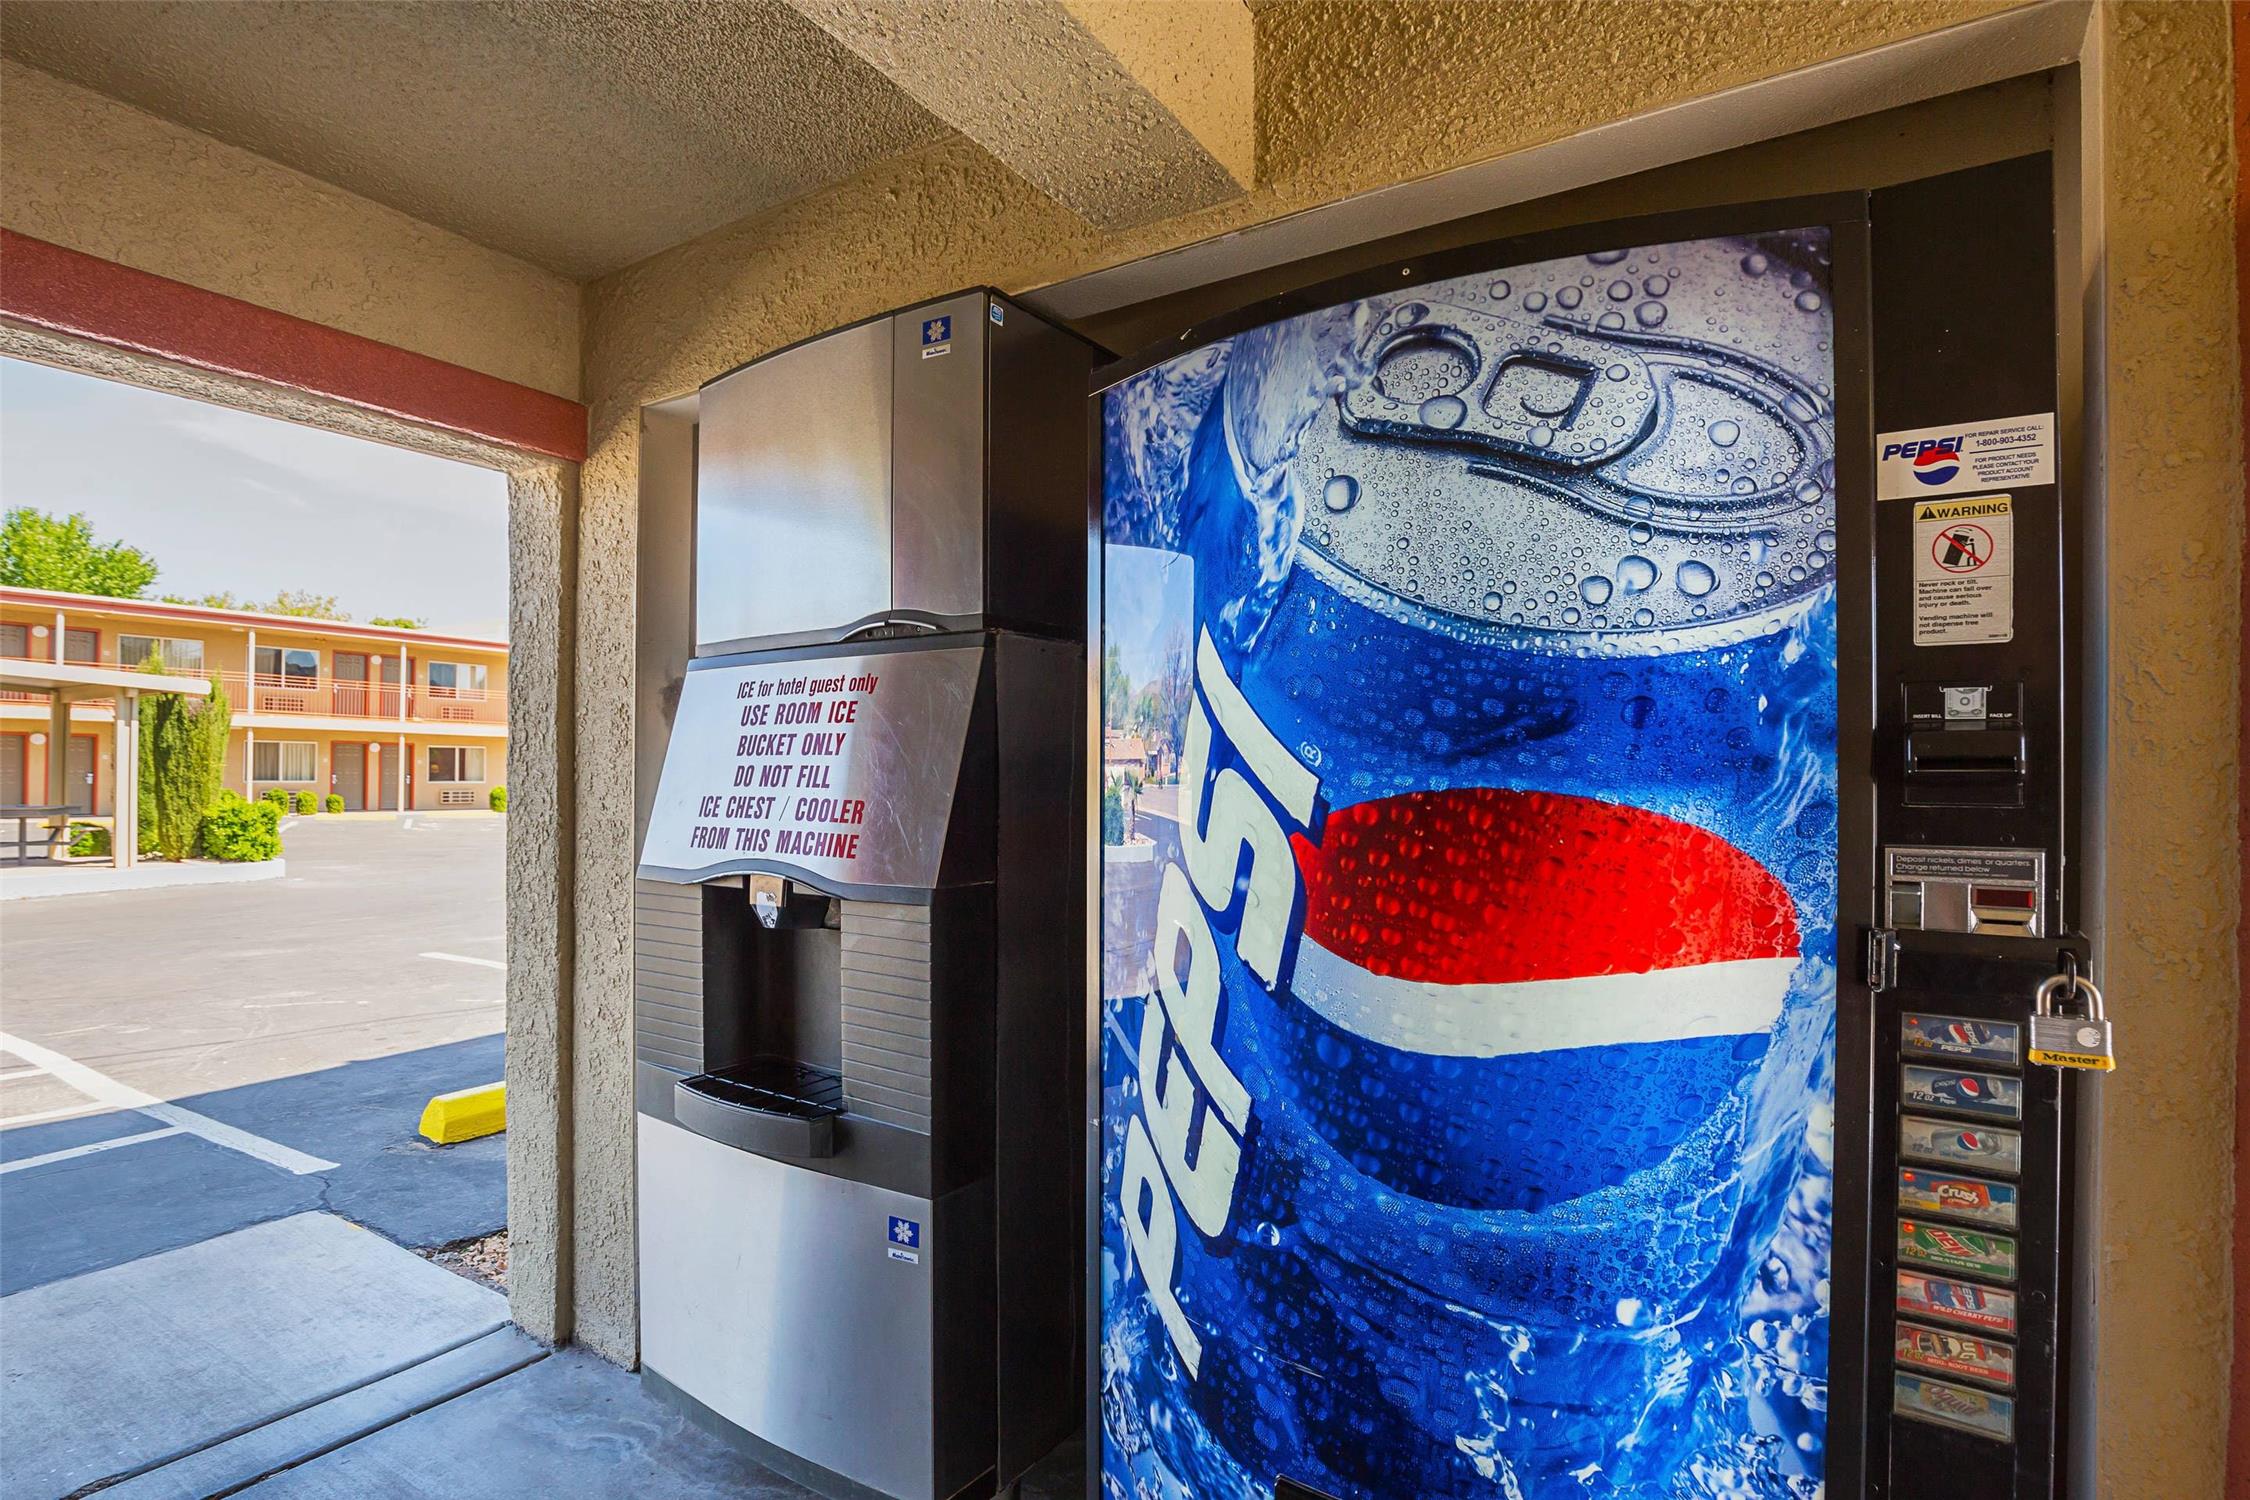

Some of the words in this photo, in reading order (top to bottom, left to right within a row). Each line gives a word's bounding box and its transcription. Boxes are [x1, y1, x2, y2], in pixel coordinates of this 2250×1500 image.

[2000, 427, 2025, 435] SERVICE
[1976, 433, 2036, 447] 1-800-903-4352
[1882, 436, 1964, 461] PEPSI
[1972, 462, 1995, 470] PLEASE
[1995, 460, 2022, 468] CONTACT
[1980, 473, 2030, 482] REPRESENTATIVE
[1937, 503, 2008, 518] WARNING
[737, 681, 756, 699] ICE
[757, 680, 774, 697] for
[776, 676, 807, 696] hotel
[809, 675, 845, 697] guest
[848, 673, 879, 694] only
[740, 704, 770, 727] USE
[774, 701, 823, 725] ROOM
[827, 700, 858, 724] ICE
[736, 733, 797, 756] BUCKET
[801, 733, 847, 756] ONLY
[733, 765, 754, 787] DO
[759, 765, 793, 788] NOT
[796, 765, 830, 788] FILL
[698, 795, 722, 818] ICE
[725, 795, 776, 820] CHEST
[778, 795, 791, 821] /
[794, 797, 866, 825] COOLER
[690, 826, 730, 850] FROM
[735, 827, 771, 853] THIS
[775, 829, 860, 859] MACHINE
[1896, 855, 1926, 863] Deposit
[1896, 863, 1929, 871] Change
[1120, 622, 1320, 1381] PEPSI
[2043, 1053, 2100, 1065] Master
[1912, 1091, 1923, 1100] 12
[1924, 1094, 1935, 1102] oz
[1937, 1185, 1980, 1204] Crush
[1933, 1305, 1953, 1313] WILD
[1953, 1309, 1983, 1319] CHERRY
